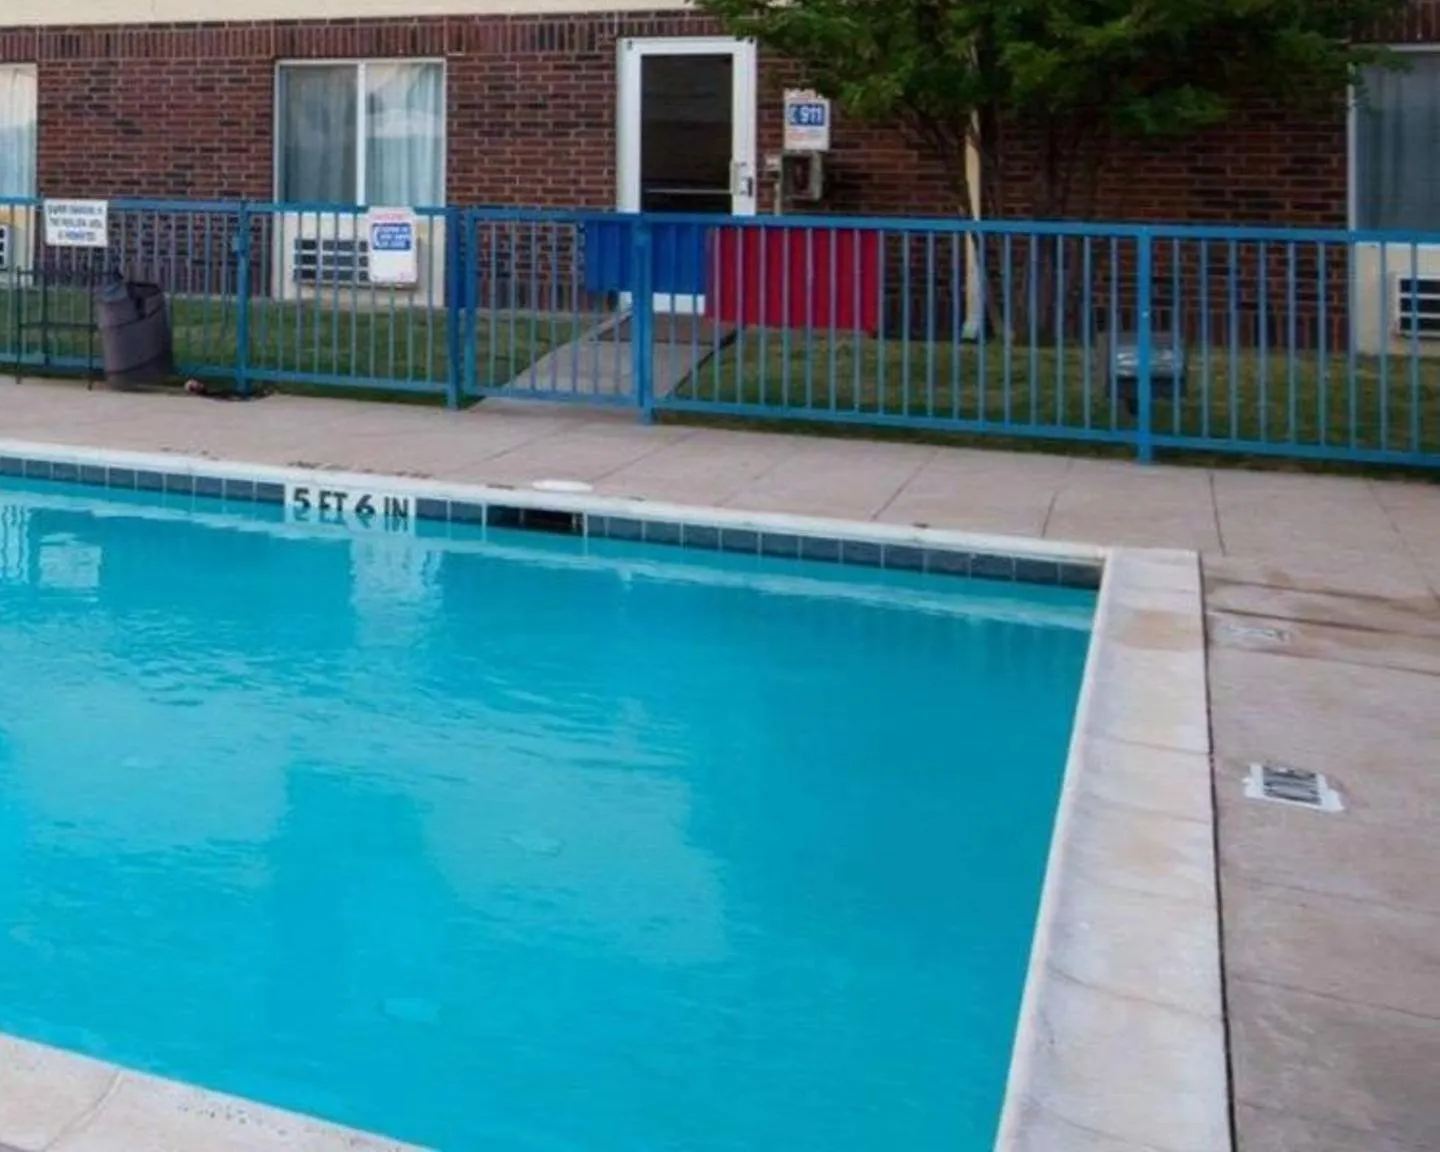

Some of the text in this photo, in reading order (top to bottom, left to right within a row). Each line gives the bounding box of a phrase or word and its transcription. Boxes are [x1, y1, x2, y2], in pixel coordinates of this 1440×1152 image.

[799, 106, 823, 123] 911
[293, 487, 409, 518] 5 FT 6 IN
